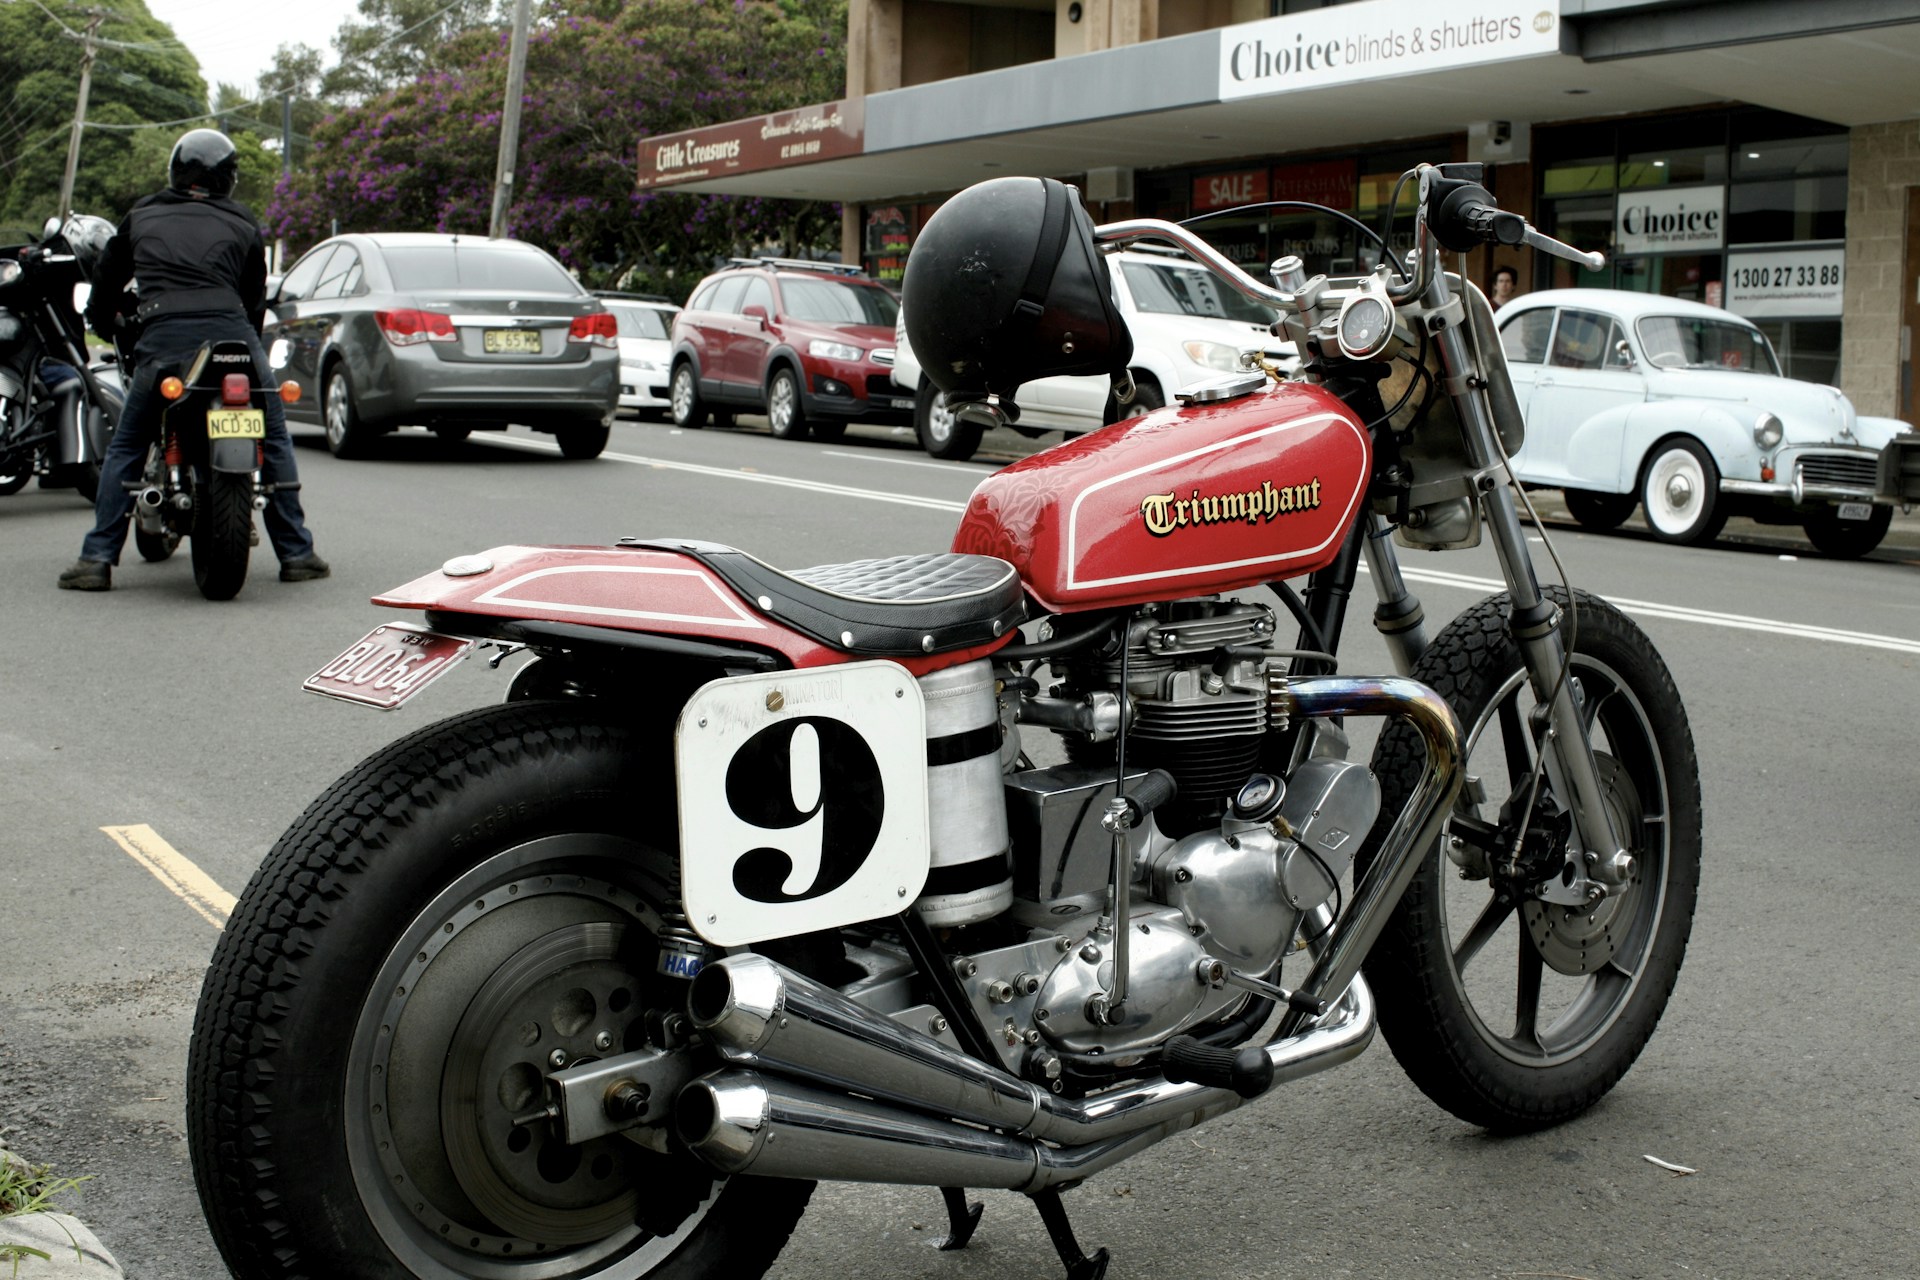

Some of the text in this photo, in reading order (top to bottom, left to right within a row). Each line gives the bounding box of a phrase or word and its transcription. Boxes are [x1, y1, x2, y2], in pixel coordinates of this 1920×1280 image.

[1230, 33, 1341, 82] Choice
[1345, 27, 1406, 65] blinds
[1411, 27, 1425, 55] &
[1430, 15, 1522, 51] shutters
[656, 139, 740, 172] Little Treasures
[1209, 175, 1254, 207] SALE
[1274, 173, 1353, 198] PETERSHAM
[1622, 203, 1719, 235] Choice
[1283, 238, 1341, 255] RECORDS
[1733, 265, 1840, 289] 1300 27 33 88
[506, 333, 520, 347] 65
[212, 354, 251, 363] DUCATI
[211, 418, 262, 434] NCD 30
[1141, 477, 1321, 538] Triumphant
[400, 634, 434, 646] NSW
[725, 715, 885, 904] 9
